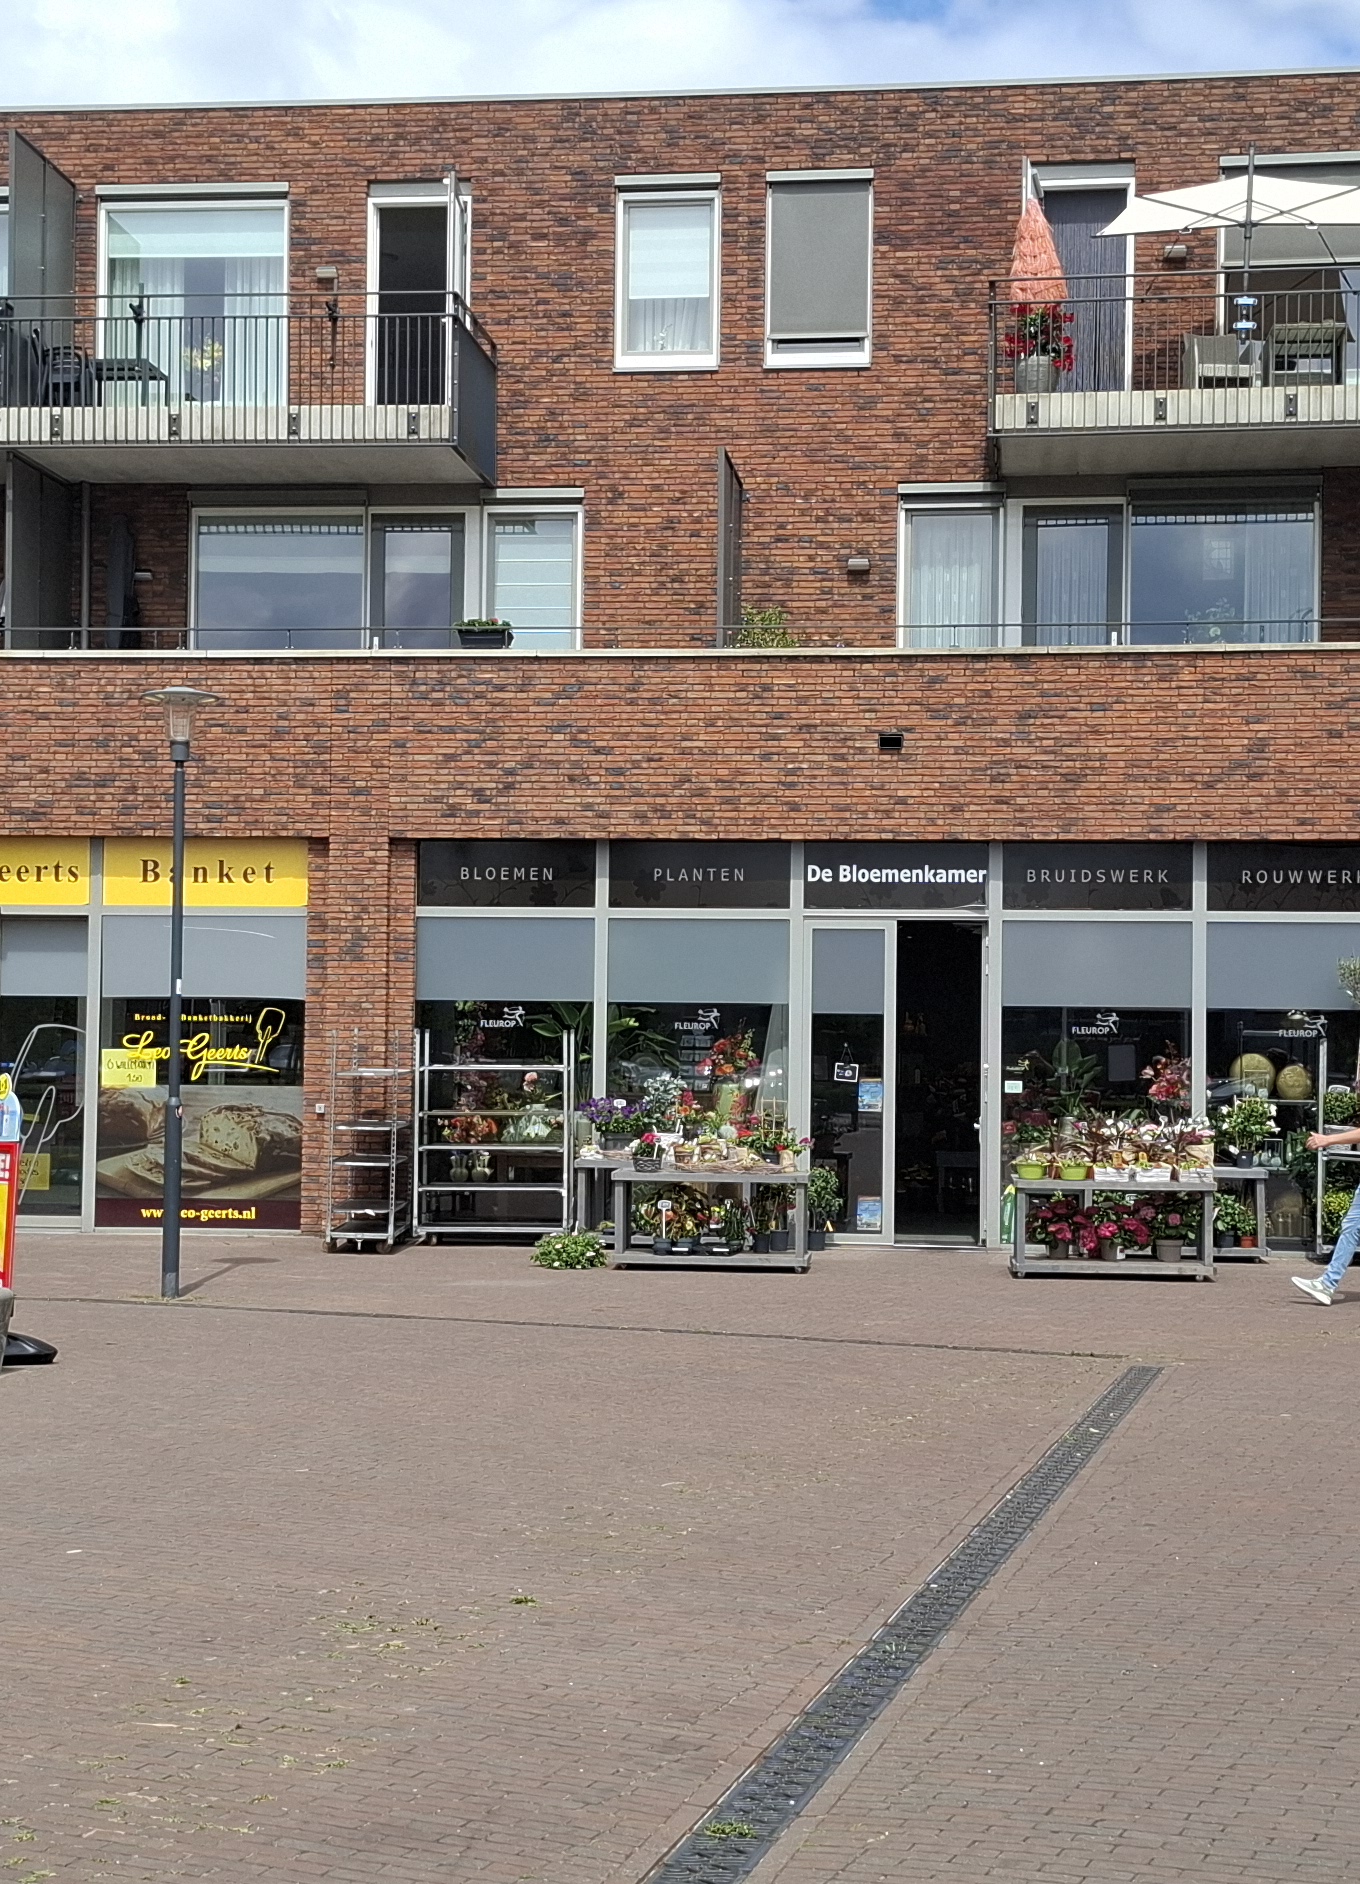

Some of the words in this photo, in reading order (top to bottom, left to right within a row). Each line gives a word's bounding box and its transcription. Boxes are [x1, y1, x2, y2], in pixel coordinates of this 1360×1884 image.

[140, 859, 275, 884] Bnket
[460, 867, 554, 881] BLOEMEN
[653, 868, 745, 882] PLANTEN
[807, 864, 833, 882] De
[839, 864, 987, 883] Bloemenkamer
[1026, 869, 1169, 883] BRUIDSWERK
[480, 1019, 517, 1028] FLEUROP
[674, 1021, 712, 1030] FLEUROP
[1072, 1026, 1110, 1035] FLEUROP
[1278, 1029, 1319, 1038] FLEUROP
[122, 1031, 171, 1060] Leo
[180, 1033, 252, 1081] Geerts
[140, 1206, 256, 1221] wweo-geerts.nl
